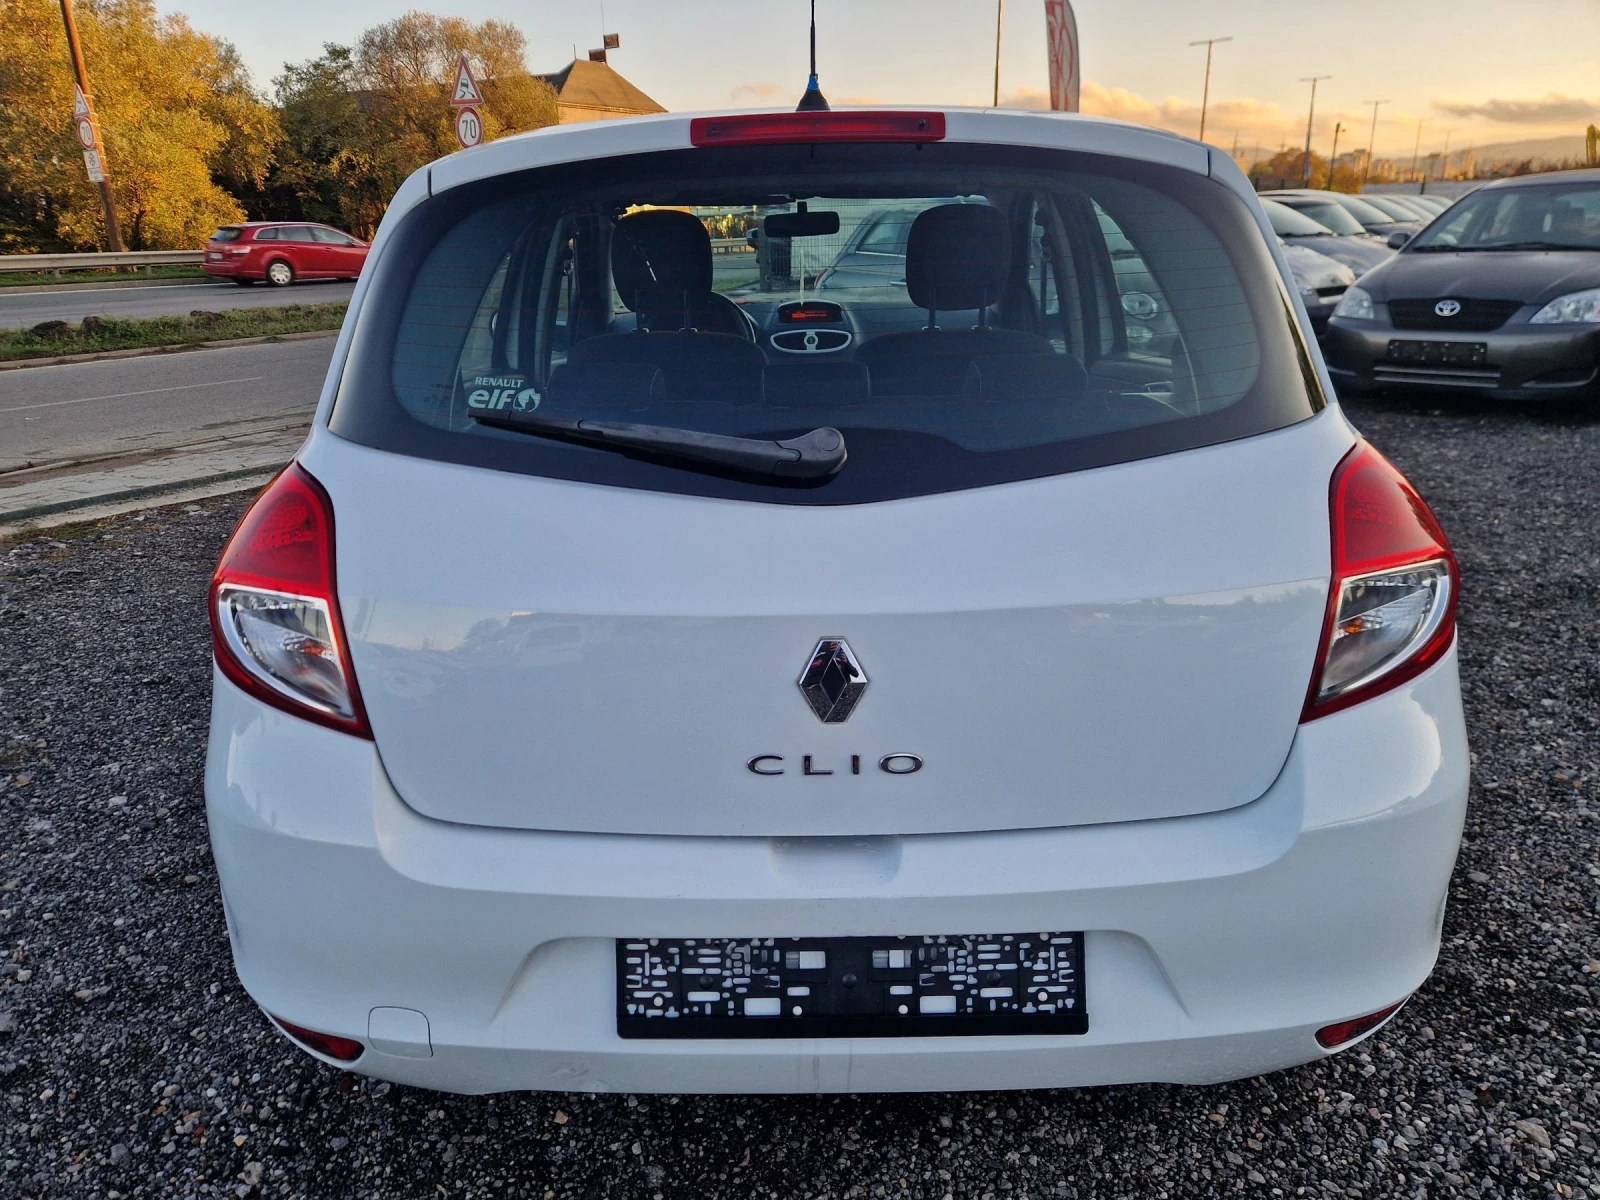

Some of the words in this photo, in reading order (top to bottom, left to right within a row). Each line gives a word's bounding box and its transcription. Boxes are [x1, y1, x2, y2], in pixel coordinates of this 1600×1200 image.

[462, 119, 477, 139] 70
[474, 376, 524, 388] RENAULT
[468, 389, 515, 410] elf
[747, 752, 924, 775] CLIO
